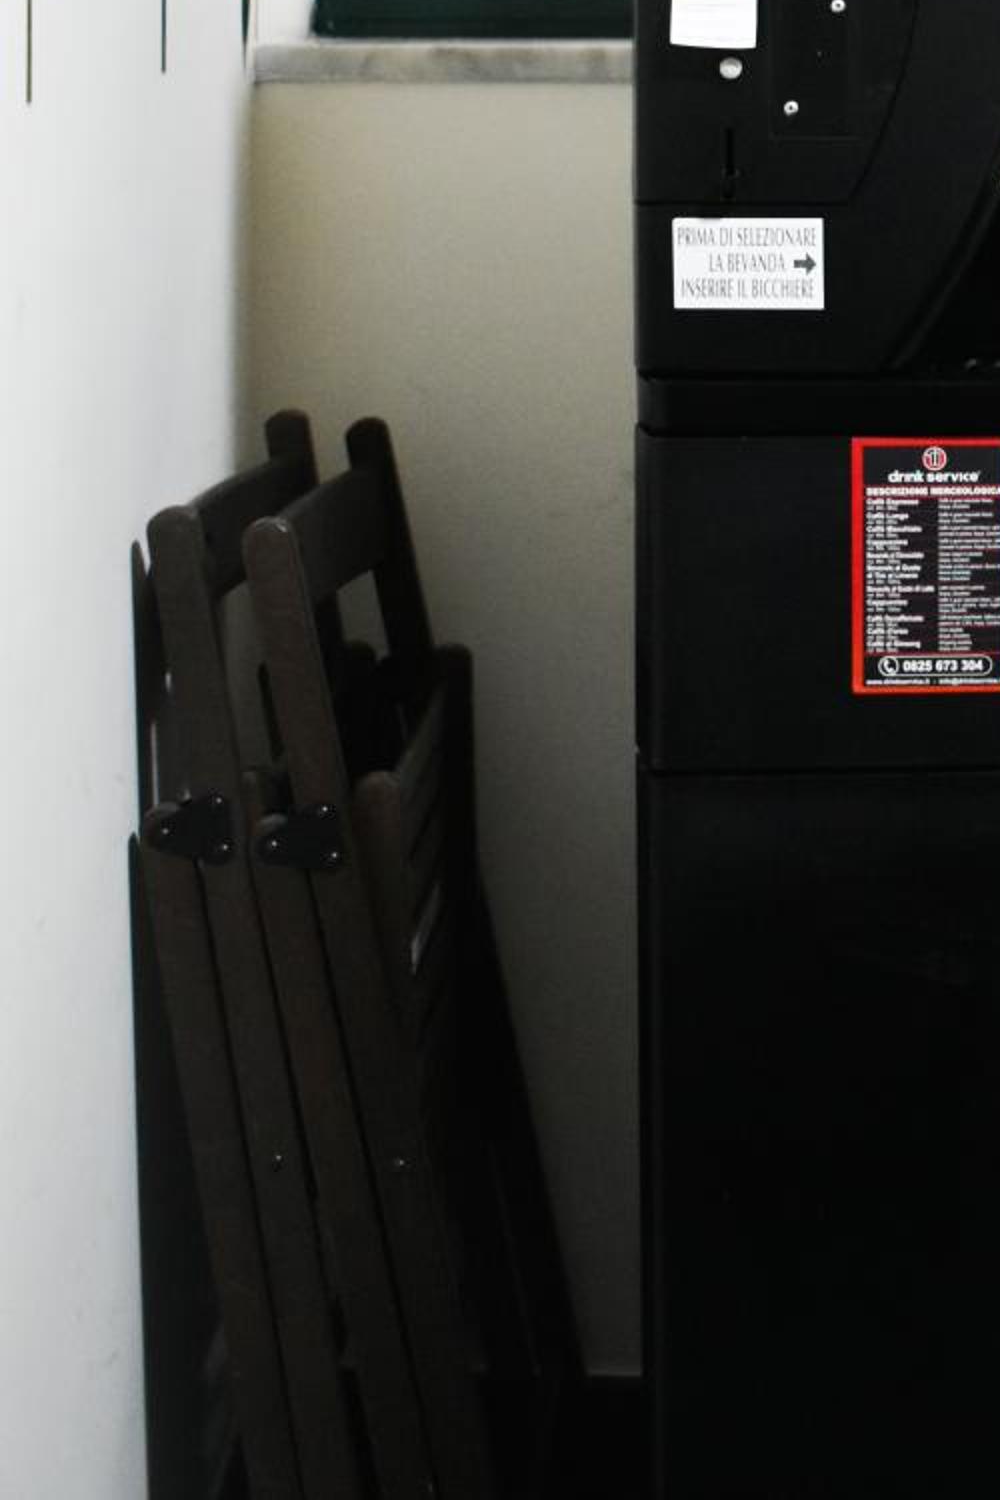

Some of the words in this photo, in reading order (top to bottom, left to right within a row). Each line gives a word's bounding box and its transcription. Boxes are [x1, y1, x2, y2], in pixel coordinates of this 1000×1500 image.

[677, 227, 715, 245] PRIMA
[720, 227, 734, 245] DI
[738, 227, 817, 247] SELEZIONARE
[709, 253, 725, 273] LA
[727, 253, 786, 273] BEVANDA
[681, 278, 735, 299] INSERIRE
[738, 278, 748, 299] IL
[752, 278, 815, 299] BICCHIERE
[888, 469, 924, 482] drink
[926, 471, 979, 483] service
[867, 486, 928, 496] DESCRIZIONE
[902, 659, 933, 672] 0825
[935, 659, 958, 672] 673
[961, 659, 983, 672] 304
